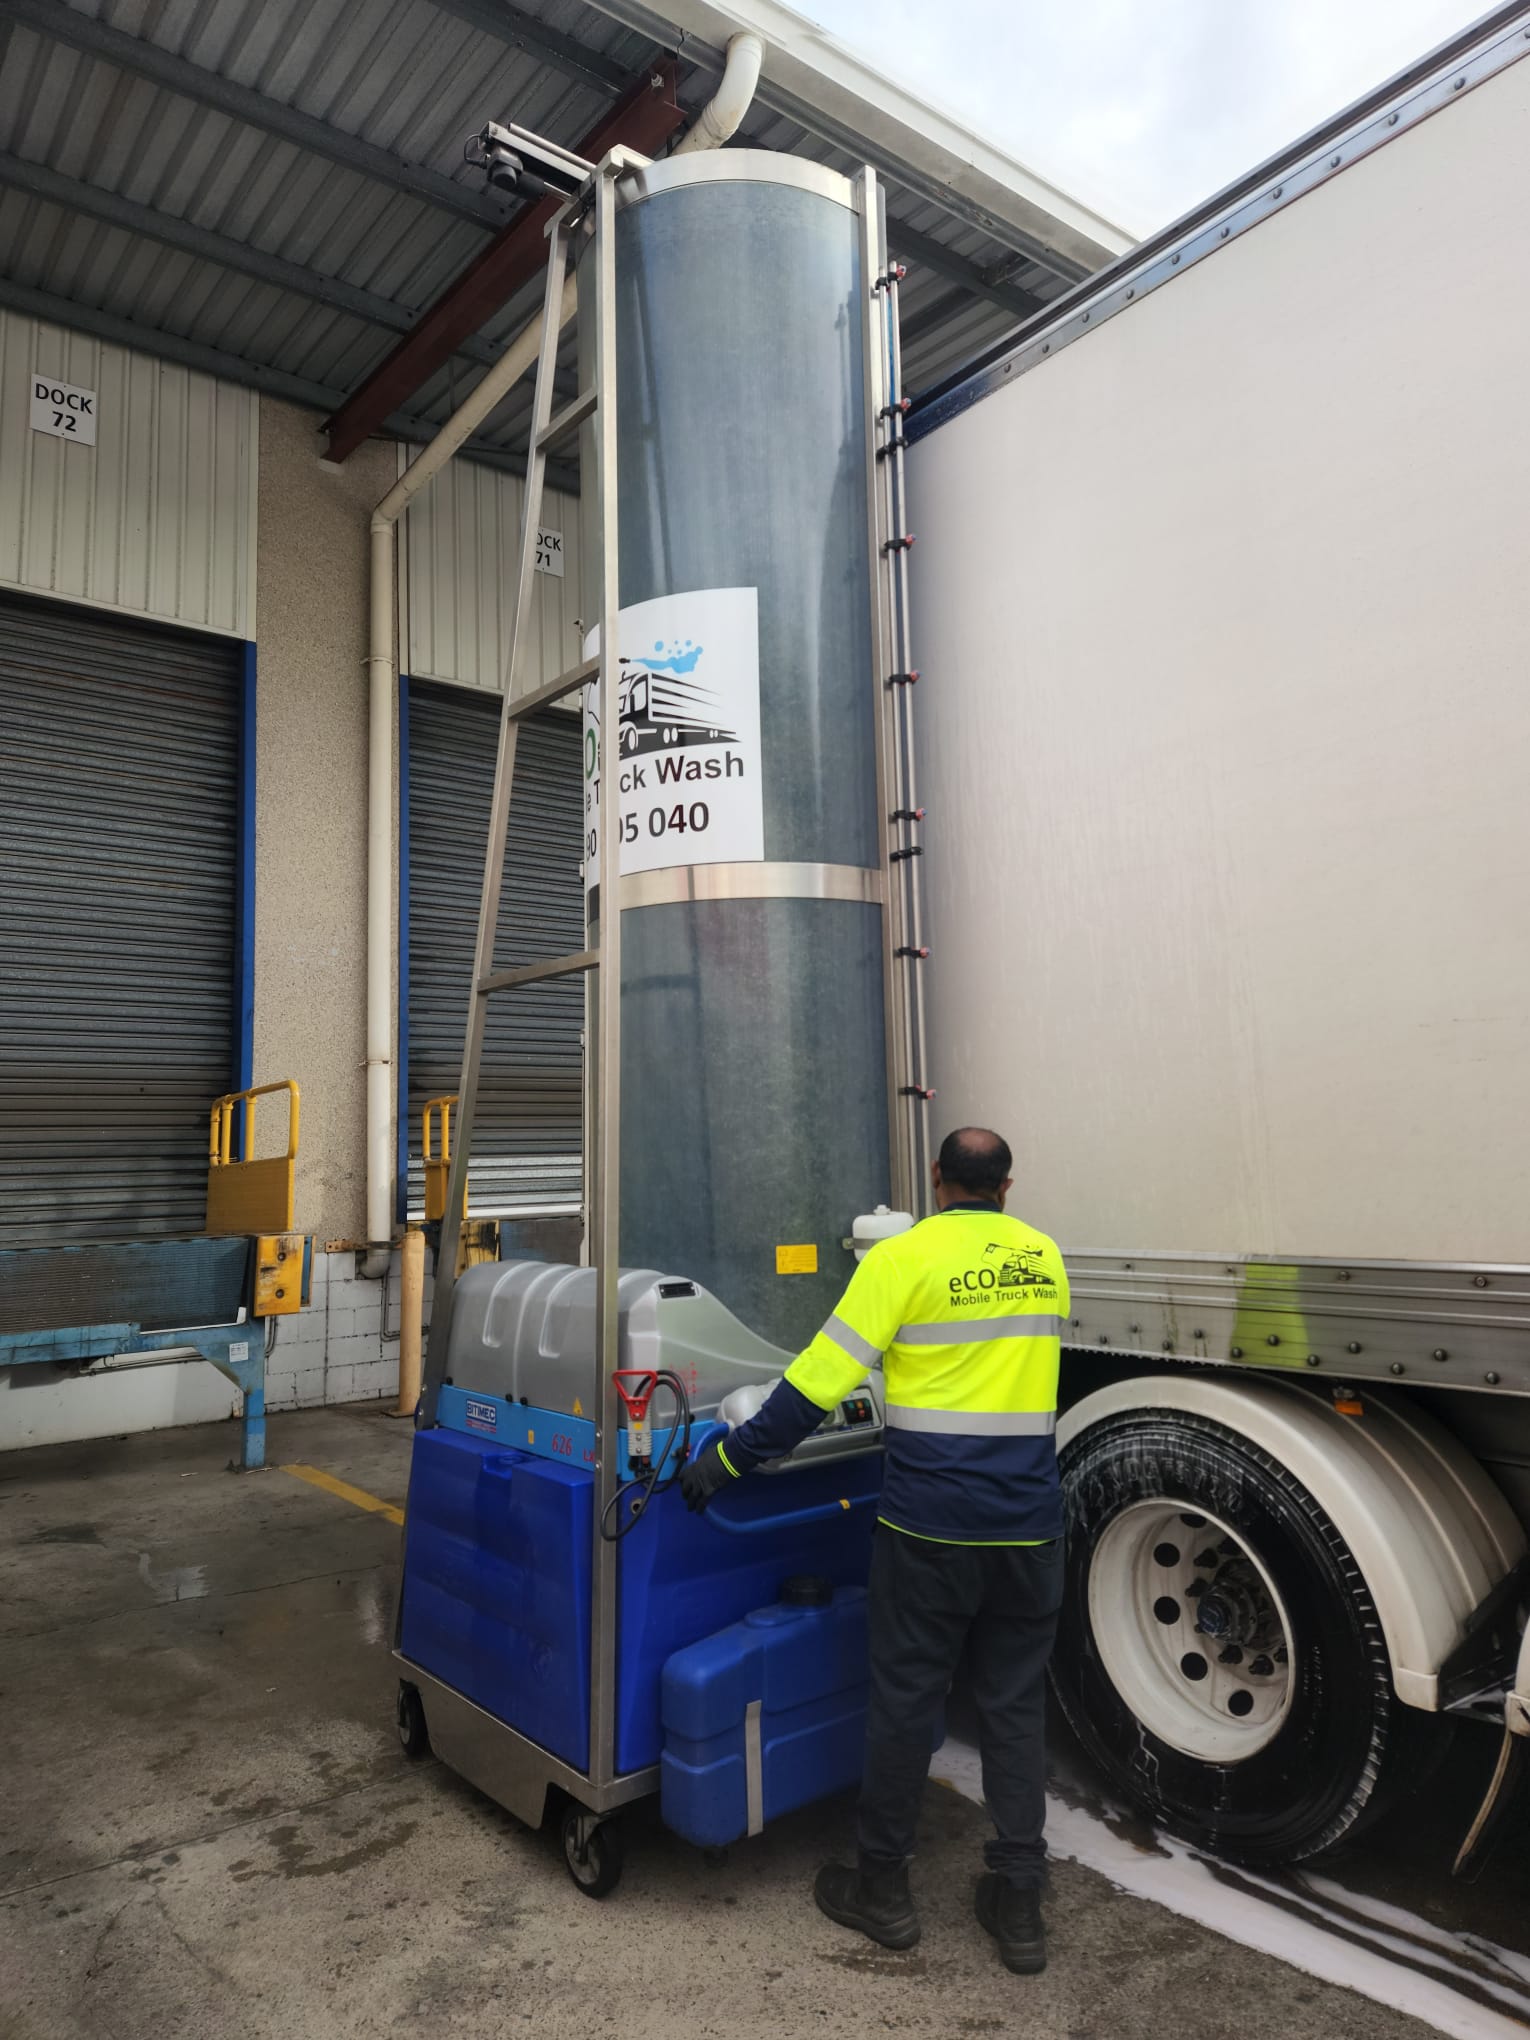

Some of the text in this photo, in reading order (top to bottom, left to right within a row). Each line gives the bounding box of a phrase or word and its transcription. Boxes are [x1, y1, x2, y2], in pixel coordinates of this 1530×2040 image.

[35, 382, 93, 415] DOCK
[52, 410, 77, 432] 72
[535, 550, 550, 567] 71
[655, 750, 744, 785] Wash
[648, 801, 709, 838] 040
[950, 1286, 1058, 1307] Mobile Truck Wash
